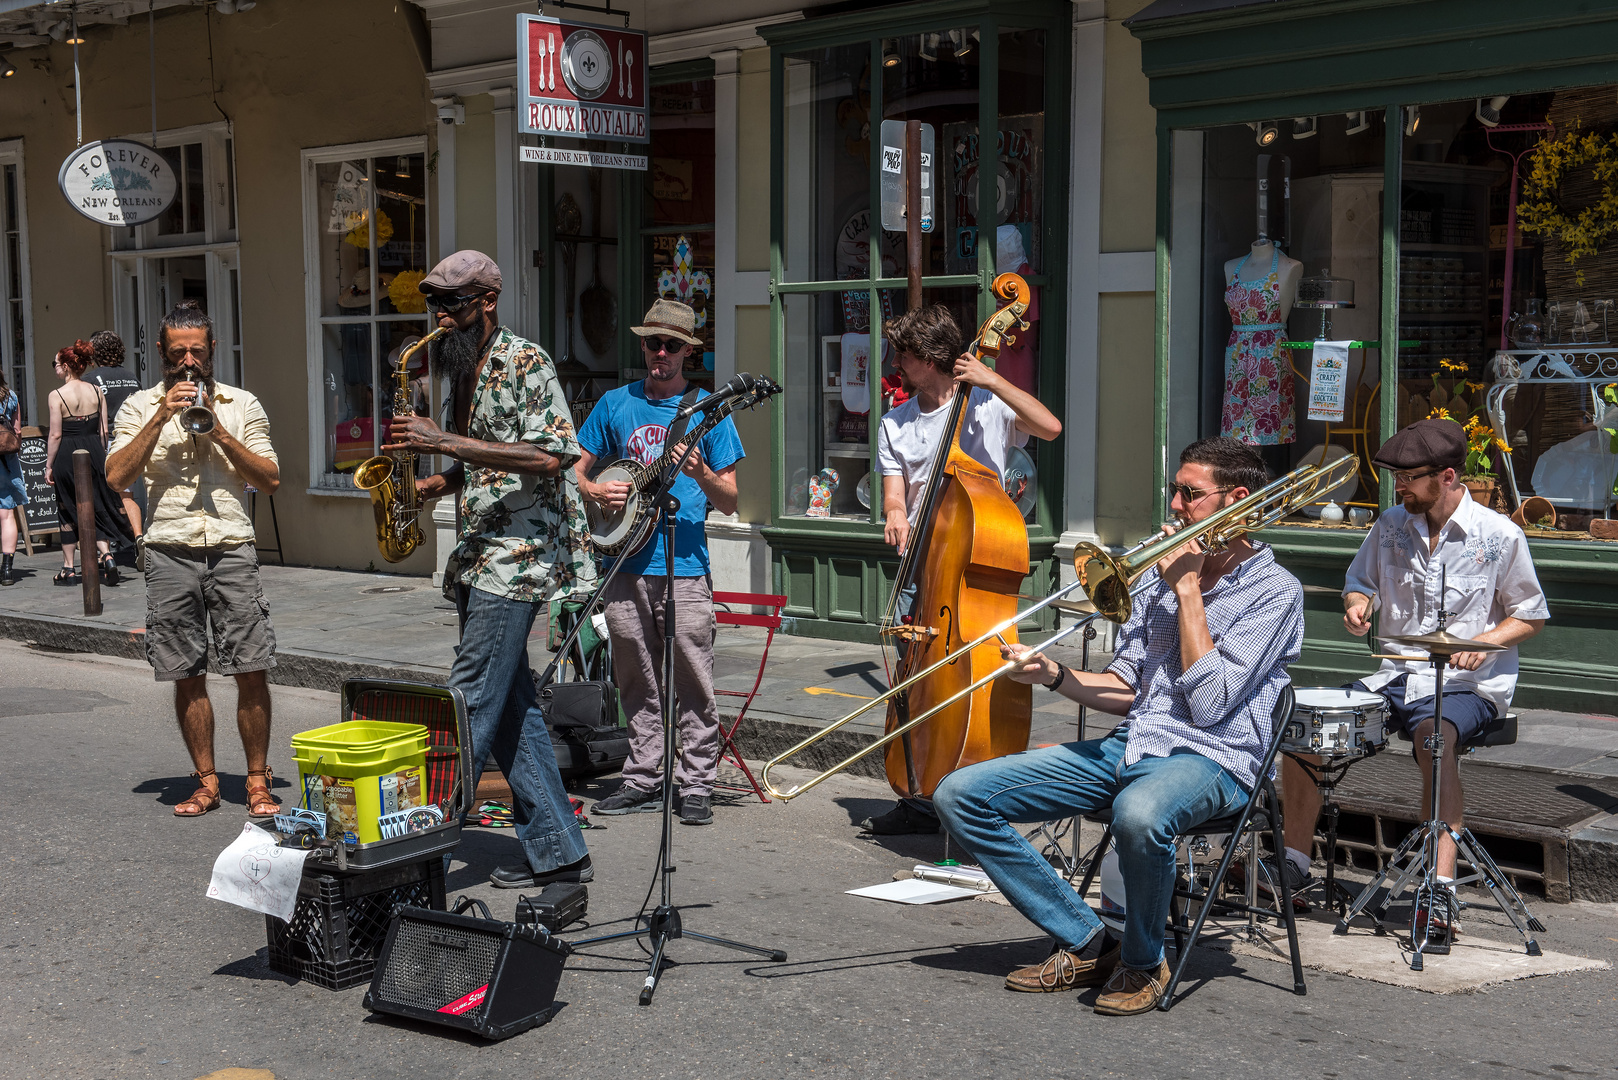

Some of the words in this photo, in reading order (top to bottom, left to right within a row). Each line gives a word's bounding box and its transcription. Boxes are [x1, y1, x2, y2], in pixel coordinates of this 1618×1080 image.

[663, 99, 692, 109] REPEAT
[529, 102, 576, 132] ROUX
[580, 108, 645, 137] ROYALE
[884, 151, 900, 162] PULPY
[953, 130, 1005, 173] SERD
[78, 149, 160, 178] FOREVER
[525, 149, 544, 160] WINE
[546, 151, 552, 160] &
[554, 151, 572, 162] DINE
[573, 153, 589, 163] NEW
[590, 154, 623, 166] ORLEANS
[624, 157, 646, 167] STYLE
[887, 160, 900, 169] PULP
[82, 197, 108, 208] NEW
[112, 197, 162, 207] ORLEANS
[122, 212, 137, 220] 2007
[845, 214, 902, 248] CRASH
[1314, 394, 1338, 402] COCKTAIL
[21, 440, 46, 450] OREVER
[28, 468, 42, 476] Home
[34, 496, 51, 504] Unique
[37, 508, 53, 516] Local
[251, 863, 260, 876] 4
[430, 932, 468, 948] CUBE
